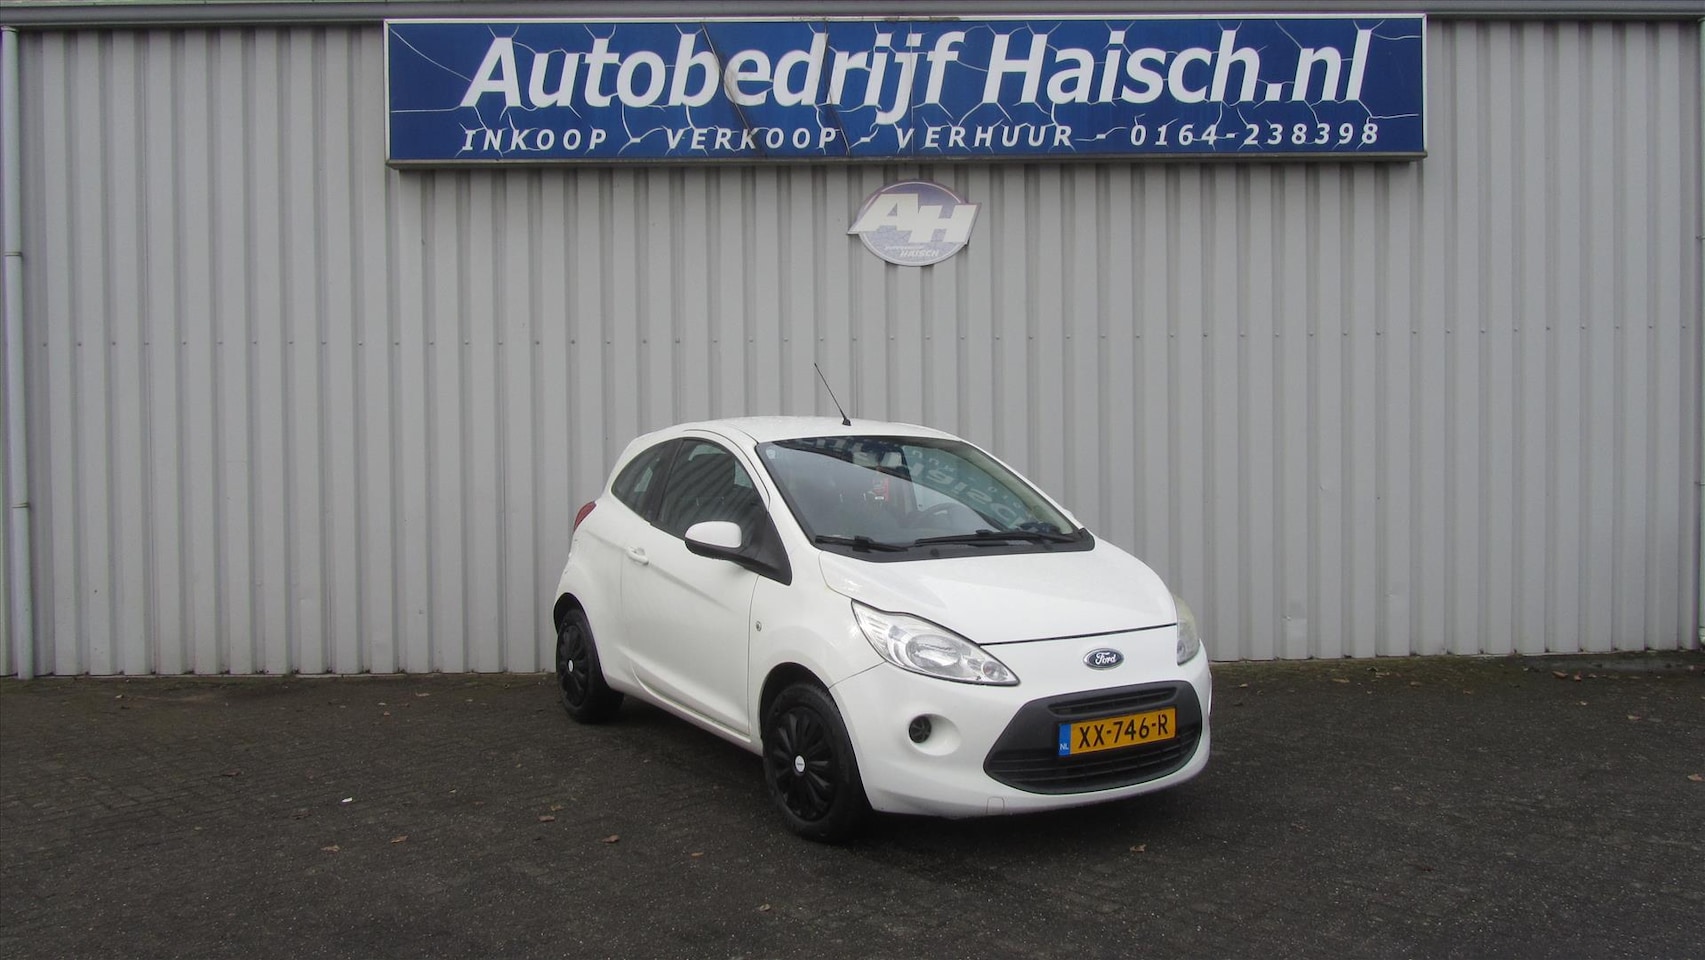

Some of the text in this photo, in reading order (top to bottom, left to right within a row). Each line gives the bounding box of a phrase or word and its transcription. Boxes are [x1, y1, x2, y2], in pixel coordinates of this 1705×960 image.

[460, 29, 1371, 126] Autobedrijf Haisch.nl
[463, 128, 608, 151] INKOOP
[666, 127, 838, 151] VERKOOP
[897, 125, 1073, 148] VERHUUR
[1130, 122, 1379, 146] 0164-238398
[853, 194, 977, 243] AH
[1094, 652, 1117, 665] Ford
[1060, 714, 1169, 751] NL XX-746-R
